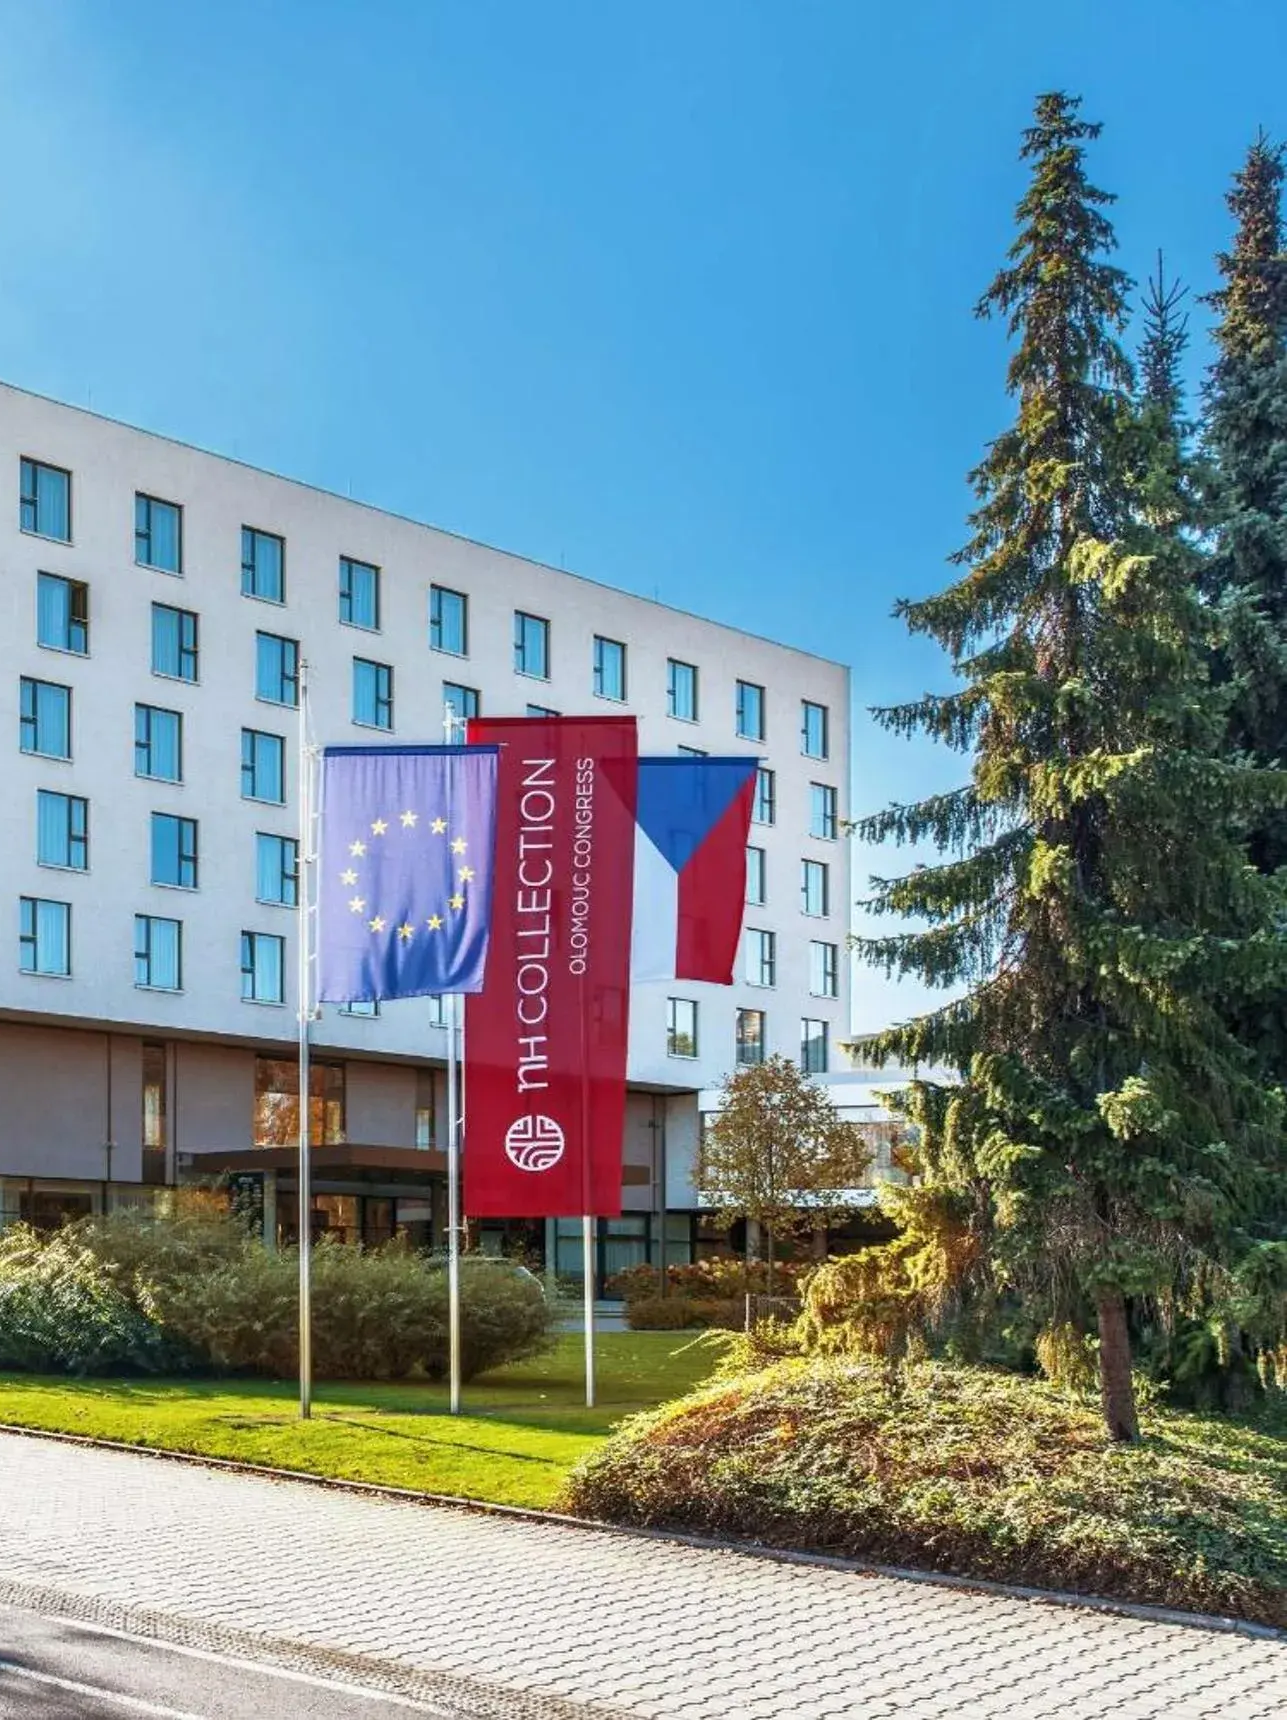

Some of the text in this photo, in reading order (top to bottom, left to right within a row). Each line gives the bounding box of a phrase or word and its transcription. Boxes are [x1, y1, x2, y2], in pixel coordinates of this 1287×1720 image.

[516, 759, 555, 1025] COLLECTION
[569, 758, 594, 975] OLOMOUC CONGRESS
